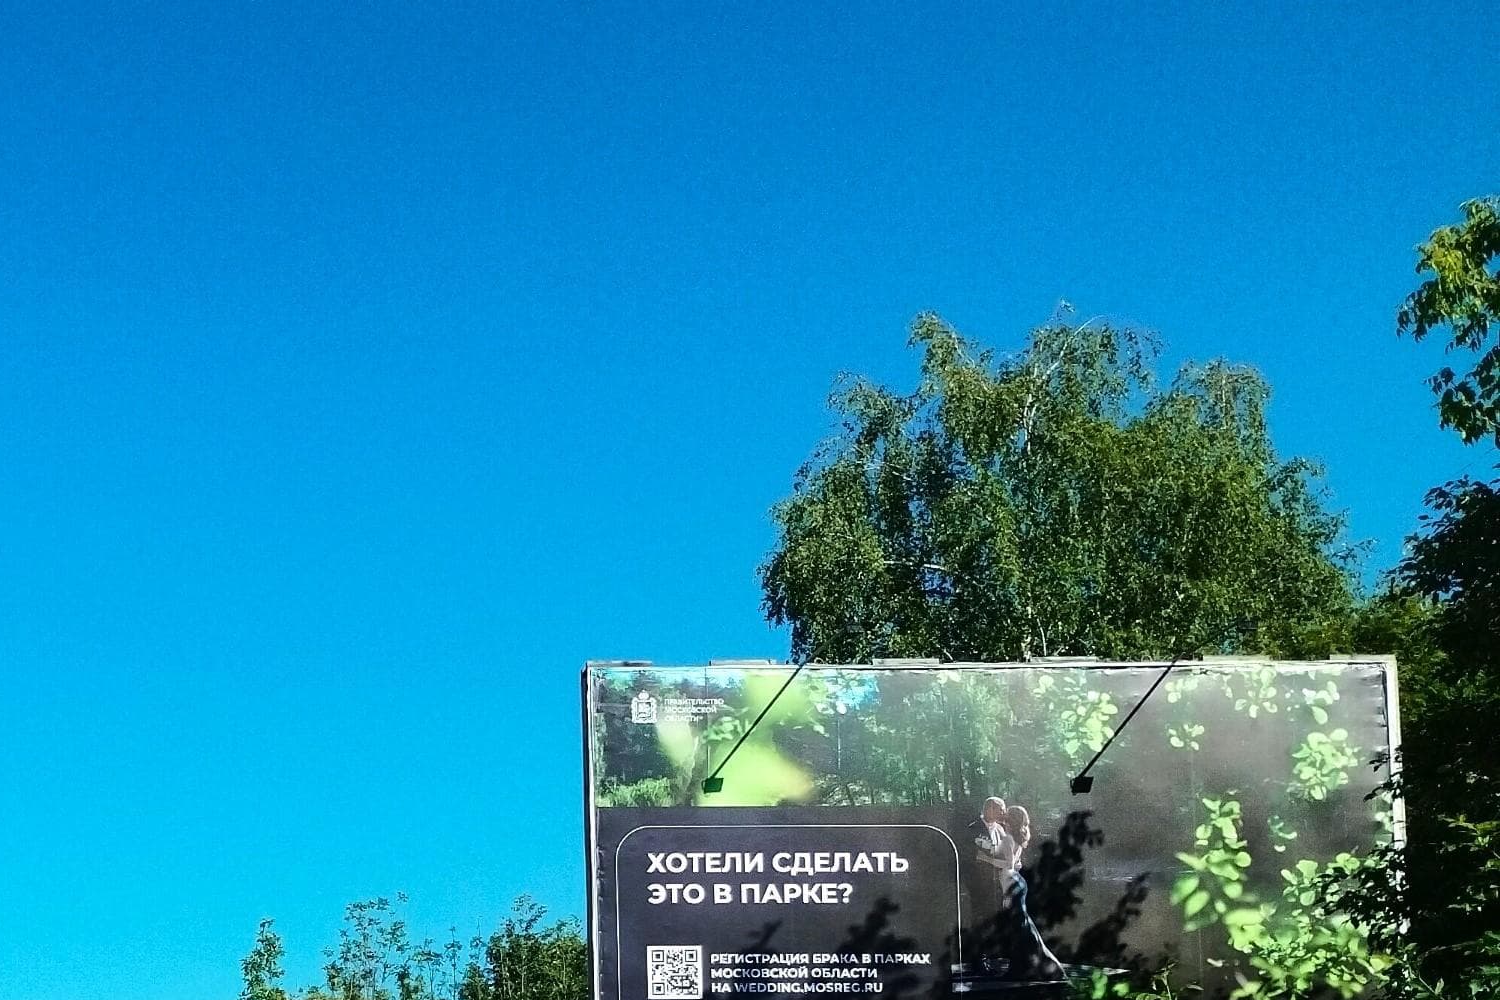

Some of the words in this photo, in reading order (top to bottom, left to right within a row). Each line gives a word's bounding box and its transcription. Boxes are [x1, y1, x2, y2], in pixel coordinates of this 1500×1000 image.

[646, 852, 764, 873] ХОТЕЛИ
[771, 852, 909, 876] СДЕЛАТЬ
[646, 883, 706, 904] ЭТО
[713, 883, 733, 904] В
[740, 883, 853, 904] ПАРКЕ?
[710, 953, 809, 966] РЕГИСТРАЦИЯ
[812, 953, 859, 964] БРАКА
[862, 953, 872, 964] В
[874, 953, 931, 964] ПАРКАХ
[710, 965, 809, 978] МОСКОВСКОЙ
[811, 967, 878, 978] ОБЛАСТИ
[711, 982, 731, 993] НА
[734, 982, 883, 993] WEDDING.MOSREG.RU
